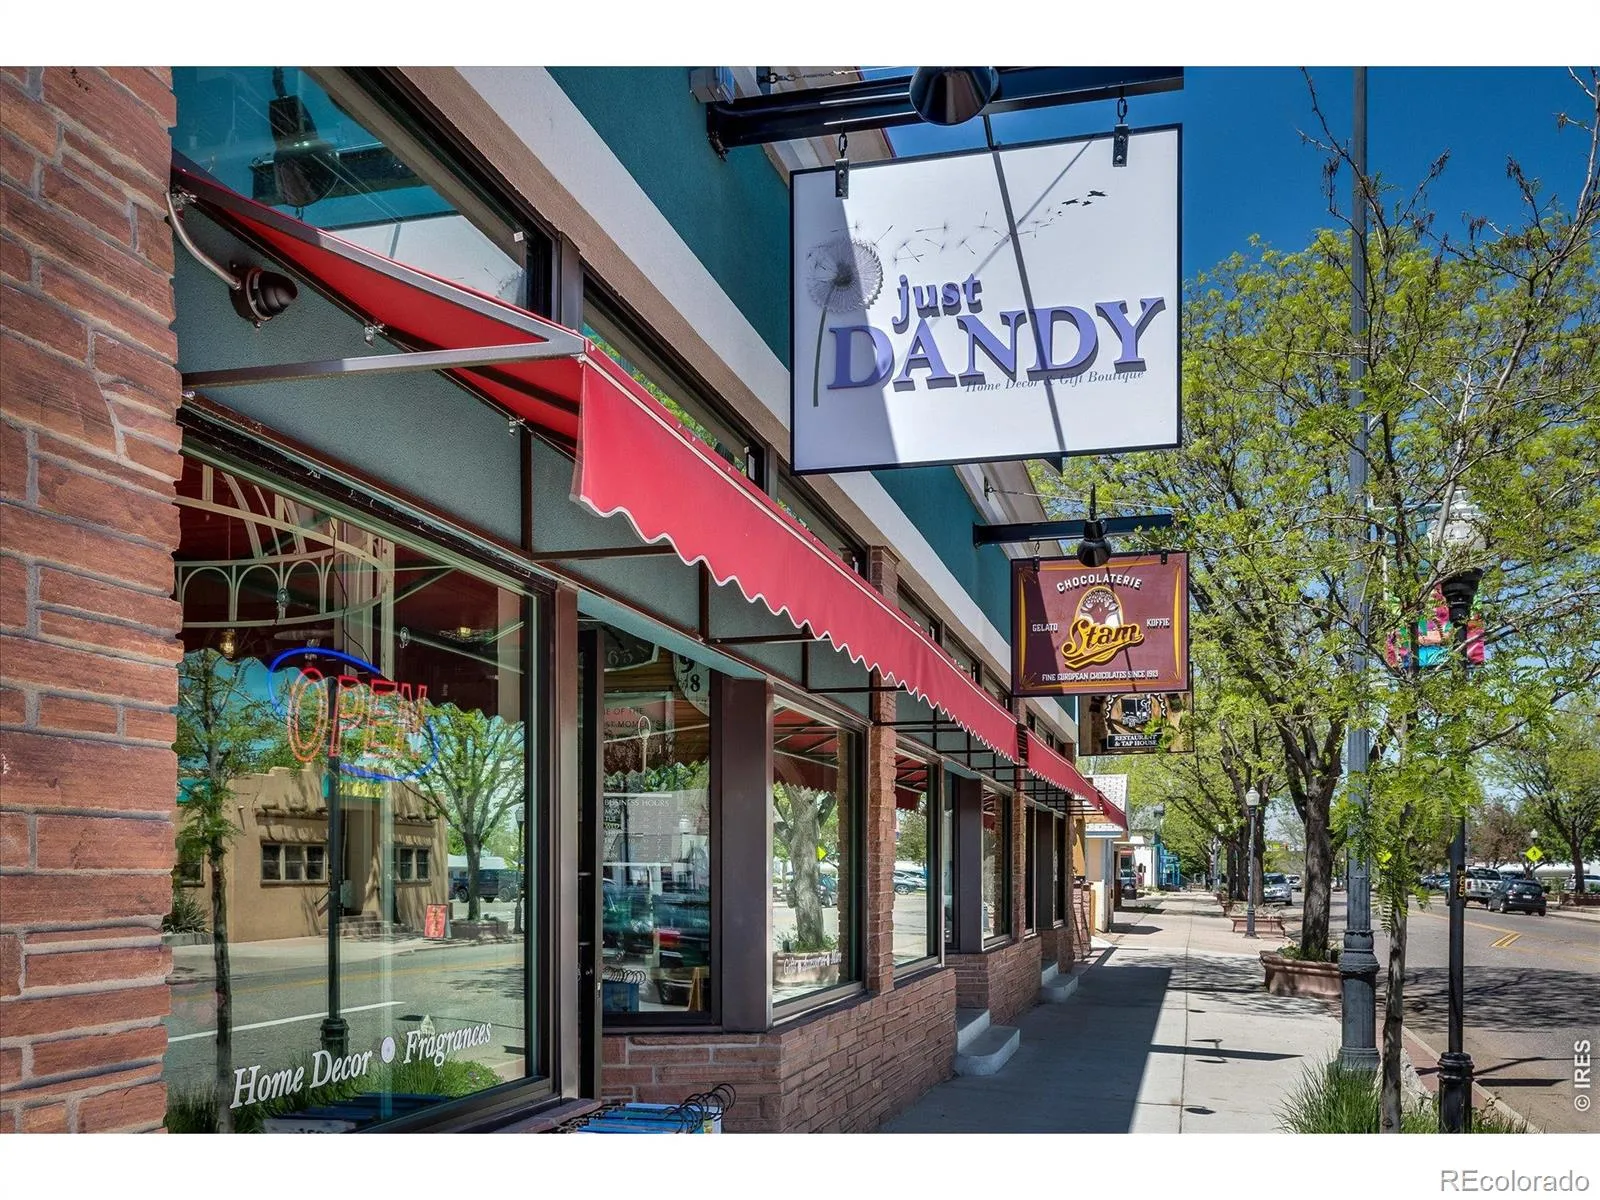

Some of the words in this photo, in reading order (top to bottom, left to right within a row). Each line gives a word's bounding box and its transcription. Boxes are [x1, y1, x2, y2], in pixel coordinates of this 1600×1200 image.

[892, 273, 982, 333] just
[827, 296, 1166, 392] DANDY
[965, 380, 1000, 392] Home
[1005, 377, 1039, 390] Decor
[1059, 372, 1083, 388] Gift
[1088, 370, 1144, 384] Boutique
[1056, 573, 1142, 592] CHOCOLATERIE
[1032, 623, 1059, 632] GELATO
[1146, 618, 1170, 628] KOFFIE
[1061, 619, 1145, 661] Stam
[1042, 673, 1056, 681] FINE
[1057, 672, 1089, 681] EUROPEAN
[1089, 671, 1127, 680] CHOCOLATES
[1127, 670, 1145, 679] SINCE
[288, 667, 427, 763] OPEN
[229, 1065, 305, 1110] Home
[309, 1049, 373, 1089] Decor
[403, 1022, 493, 1067] Fragrances
